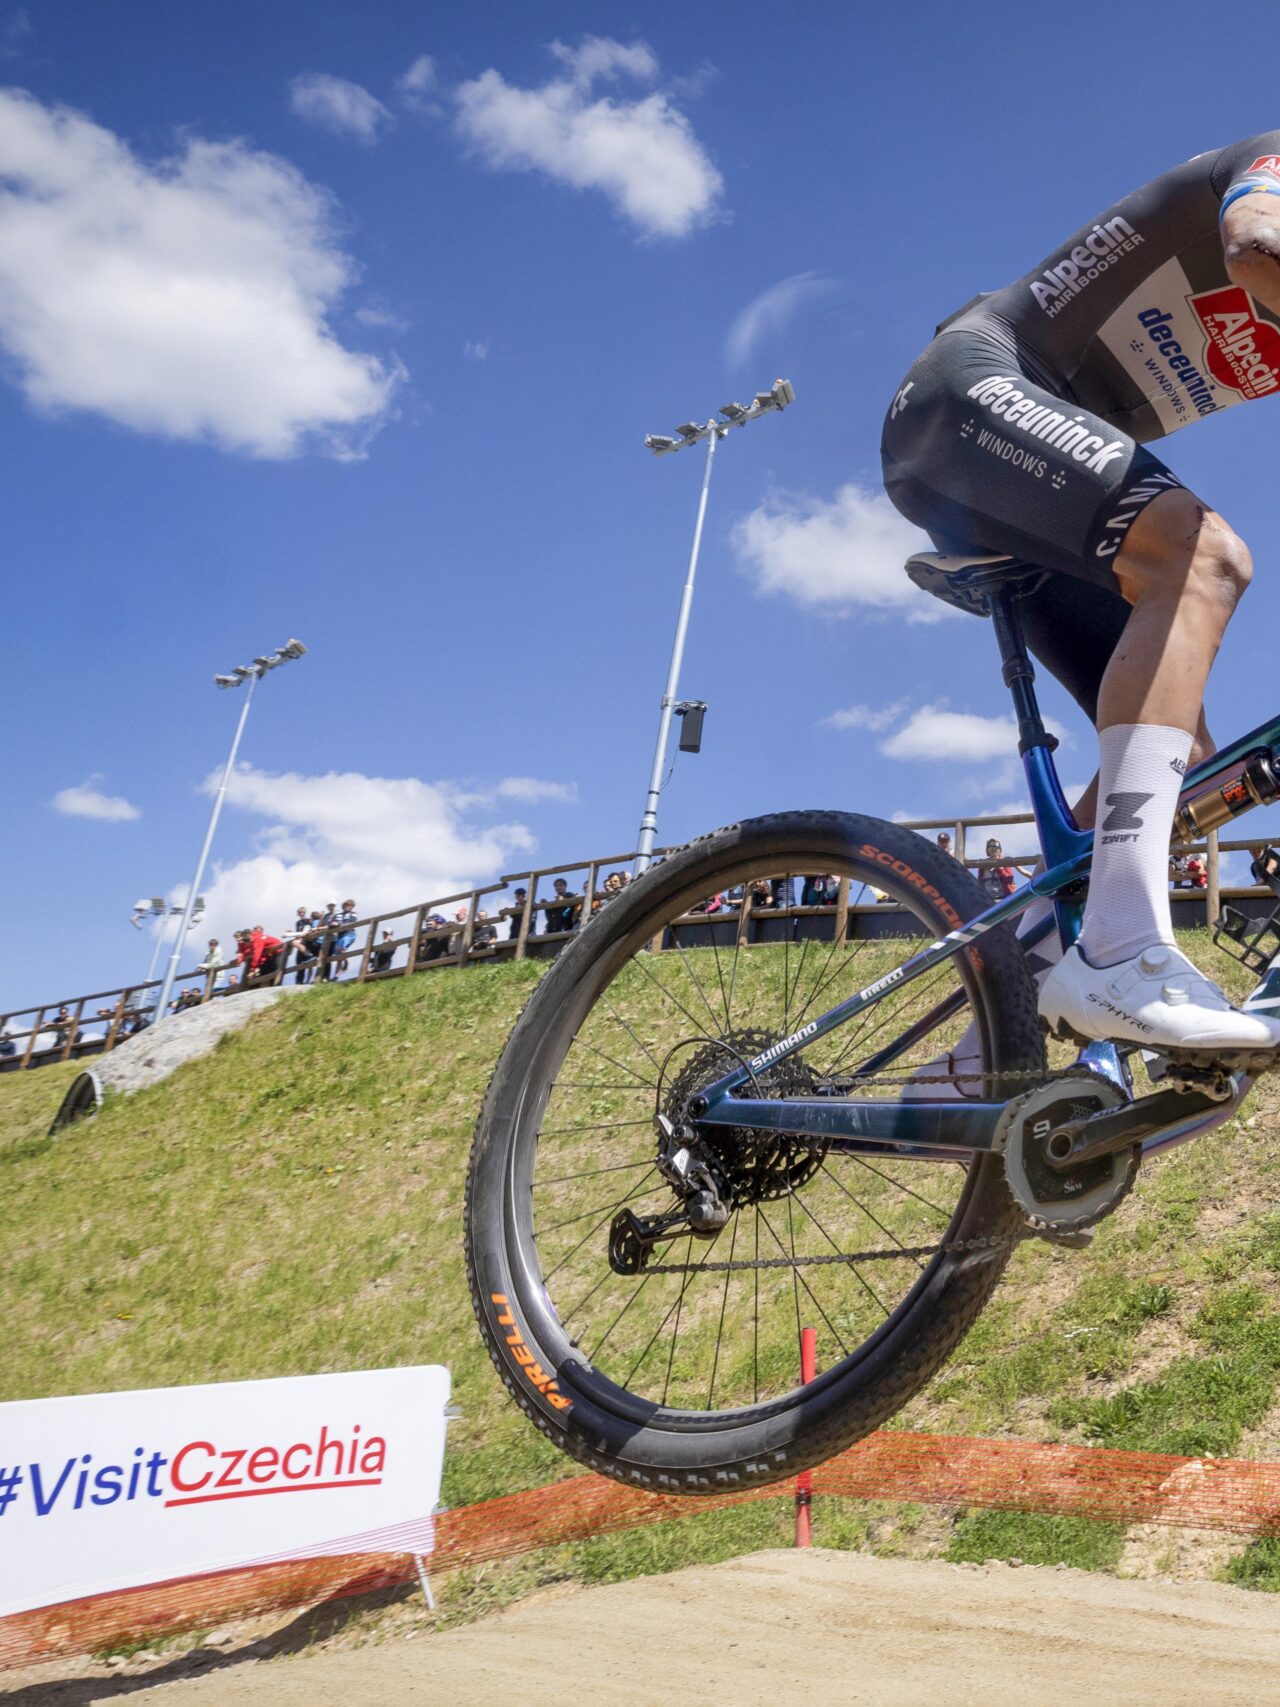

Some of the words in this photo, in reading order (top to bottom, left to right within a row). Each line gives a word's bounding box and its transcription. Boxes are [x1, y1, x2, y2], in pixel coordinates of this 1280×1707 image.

[1030, 216, 1136, 310] Alpecin
[1045, 288, 1076, 318] HAIR
[1077, 234, 1145, 288] BOOSTER
[1144, 358, 1186, 414] WINDOWS
[1203, 315, 1226, 349] HAIR
[1225, 352, 1257, 398] BOOSTER
[1213, 312, 1279, 395] Alpecin
[966, 375, 1123, 475] deceuninck
[976, 427, 1048, 479] WINDOWS
[1101, 833, 1140, 845] ZWIFT
[860, 967, 905, 1000] PIRELLI
[751, 1021, 818, 1070] SHIMANO
[491, 1293, 573, 1410] PIRELLI
[0, 1424, 387, 1516] #VisitCzechia
